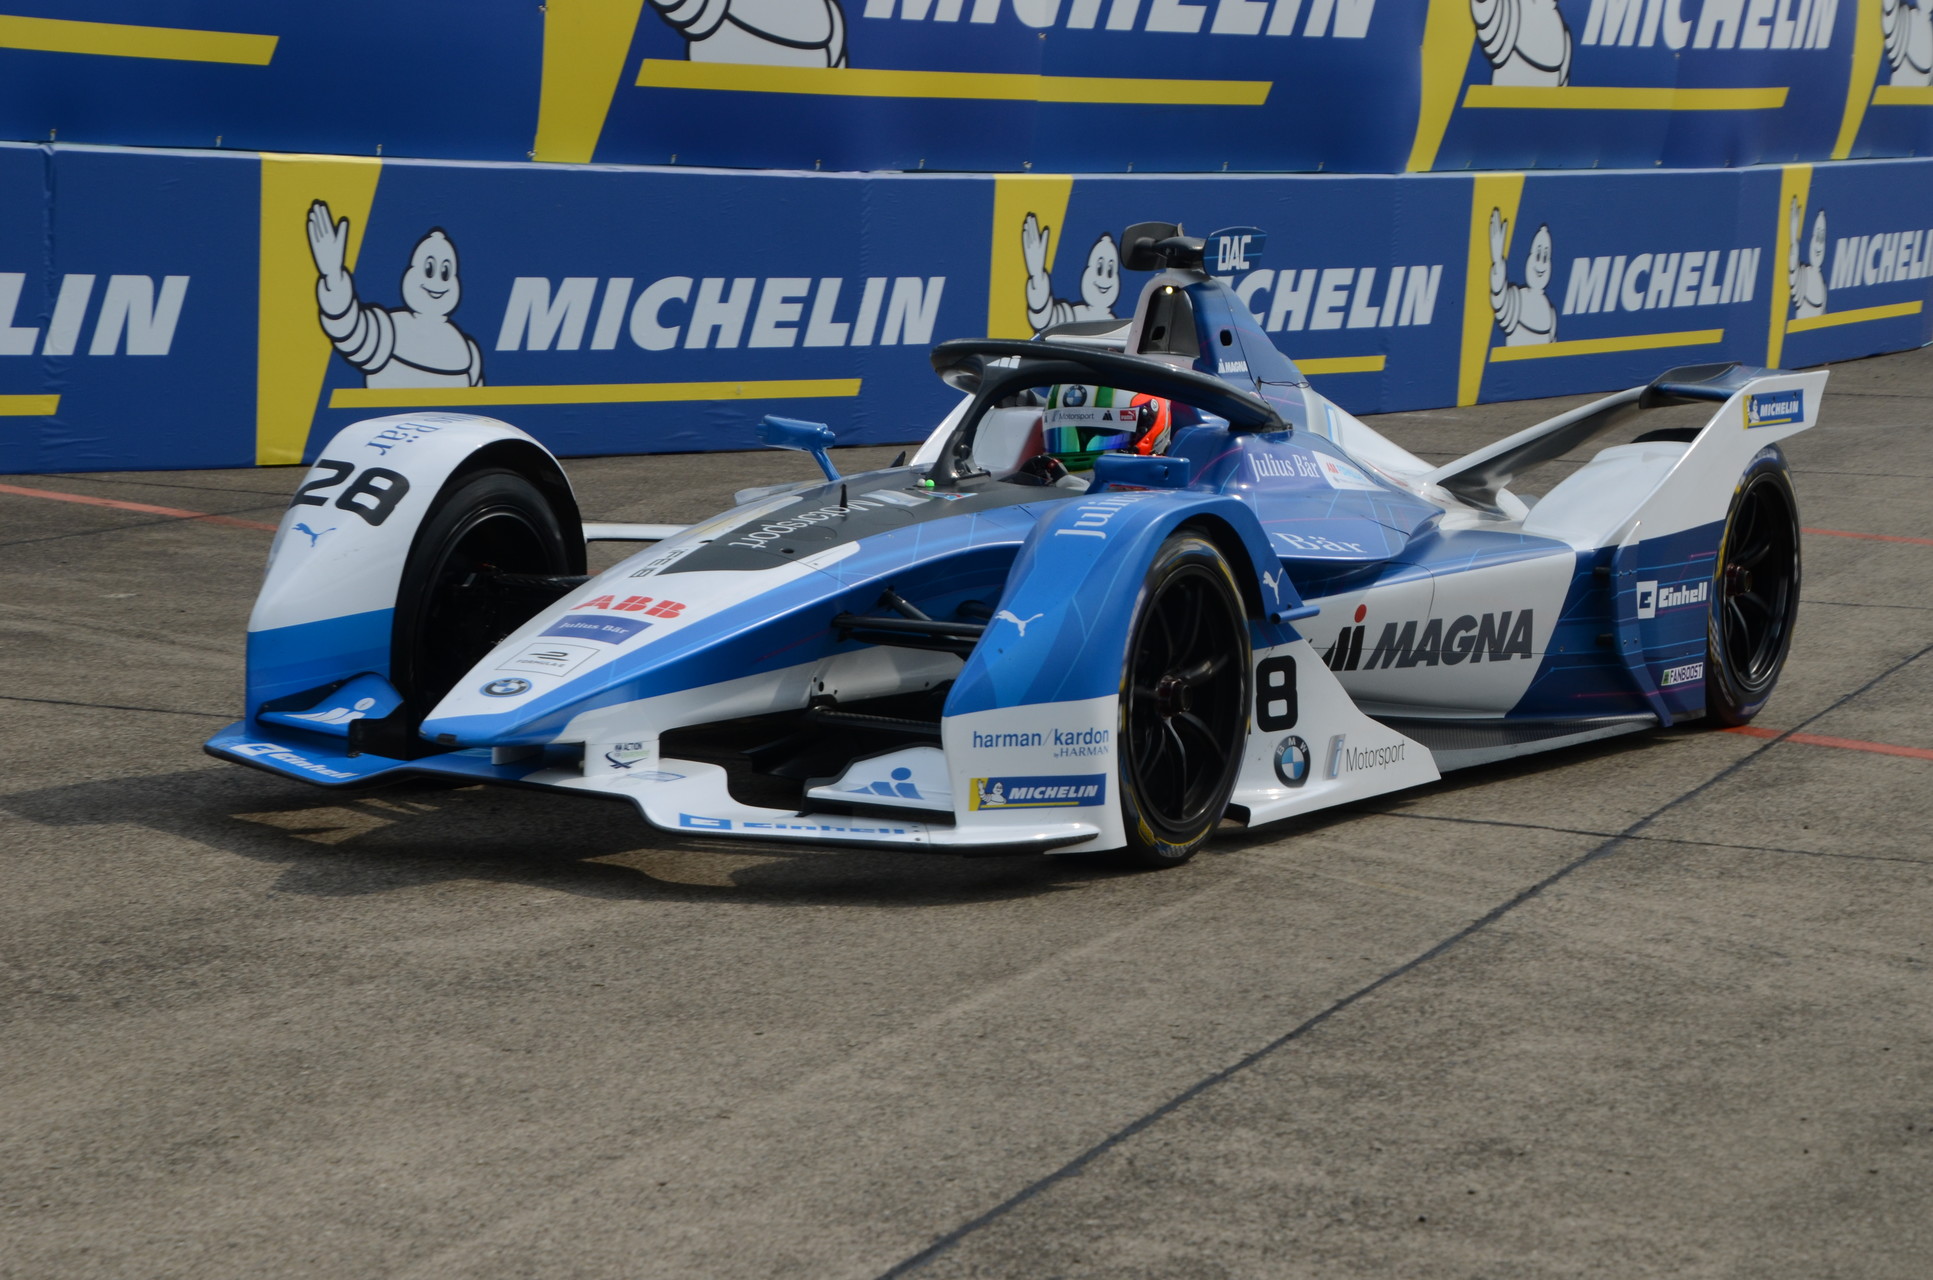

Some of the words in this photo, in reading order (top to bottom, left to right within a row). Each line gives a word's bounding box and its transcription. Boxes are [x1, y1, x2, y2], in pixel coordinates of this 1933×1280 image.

[1217, 235, 1251, 271] DAC
[1563, 248, 1760, 315] MICHELIN
[496, 276, 945, 351] MICHELIN
[1215, 265, 1442, 332] CHELIN
[1224, 360, 1248, 373] MAGNA
[1760, 401, 1799, 416] MICHELIN
[365, 422, 442, 456] Bär
[1248, 453, 1295, 483] Julius
[1292, 454, 1320, 478] Bär
[289, 459, 411, 526] 28
[1272, 532, 1368, 554] Bär
[569, 595, 687, 619] ABB
[1659, 582, 1708, 609] Einhell
[1362, 608, 1534, 671] MAGNA
[1670, 664, 1703, 680] FANBOOST
[1249, 655, 1298, 733] 8
[1345, 740, 1405, 773] Motorsport
[1009, 785, 1098, 800] MICHELIN
